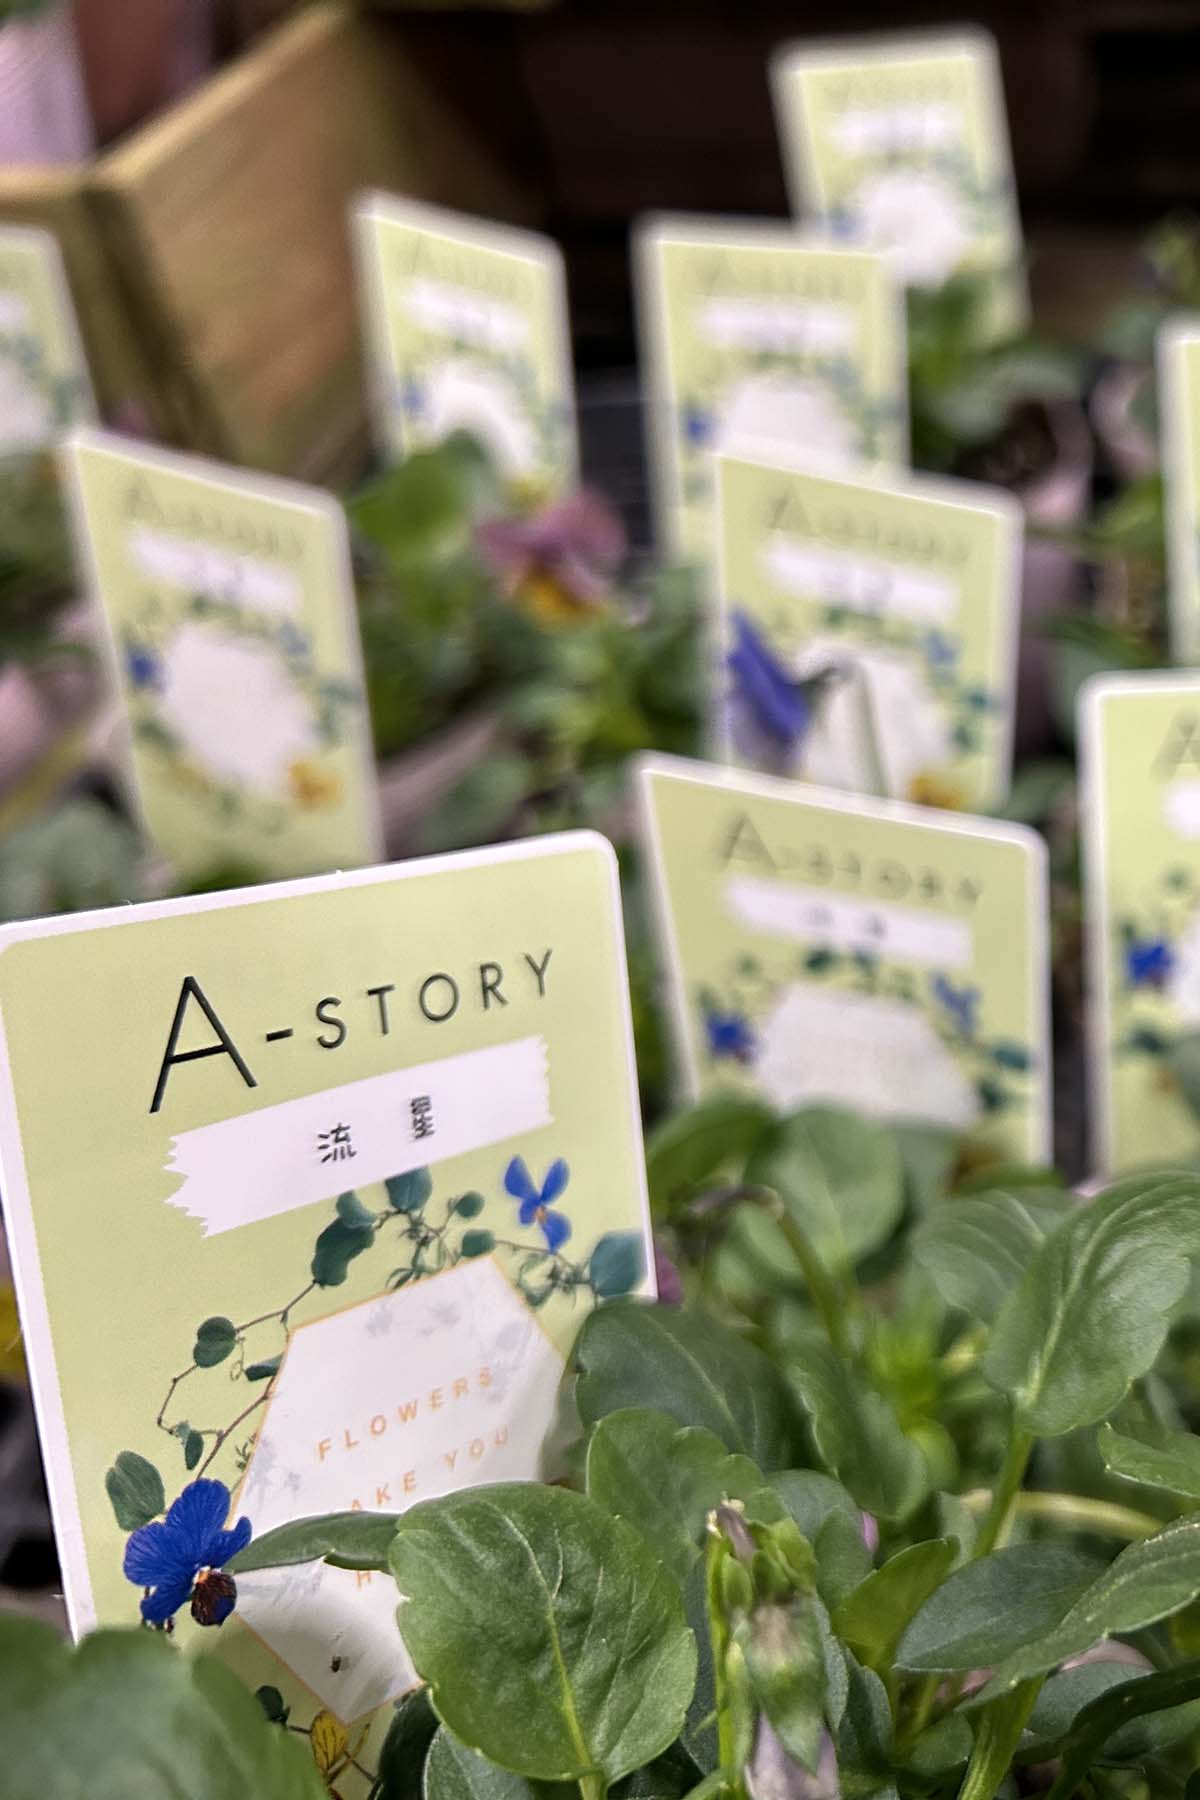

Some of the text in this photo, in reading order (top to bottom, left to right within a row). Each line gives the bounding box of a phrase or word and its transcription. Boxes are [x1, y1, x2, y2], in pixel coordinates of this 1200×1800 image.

[149, 948, 552, 1113] A-STORY
[318, 1367, 493, 1462] FLOWERS
[328, 1424, 509, 1514] AKE YOU
